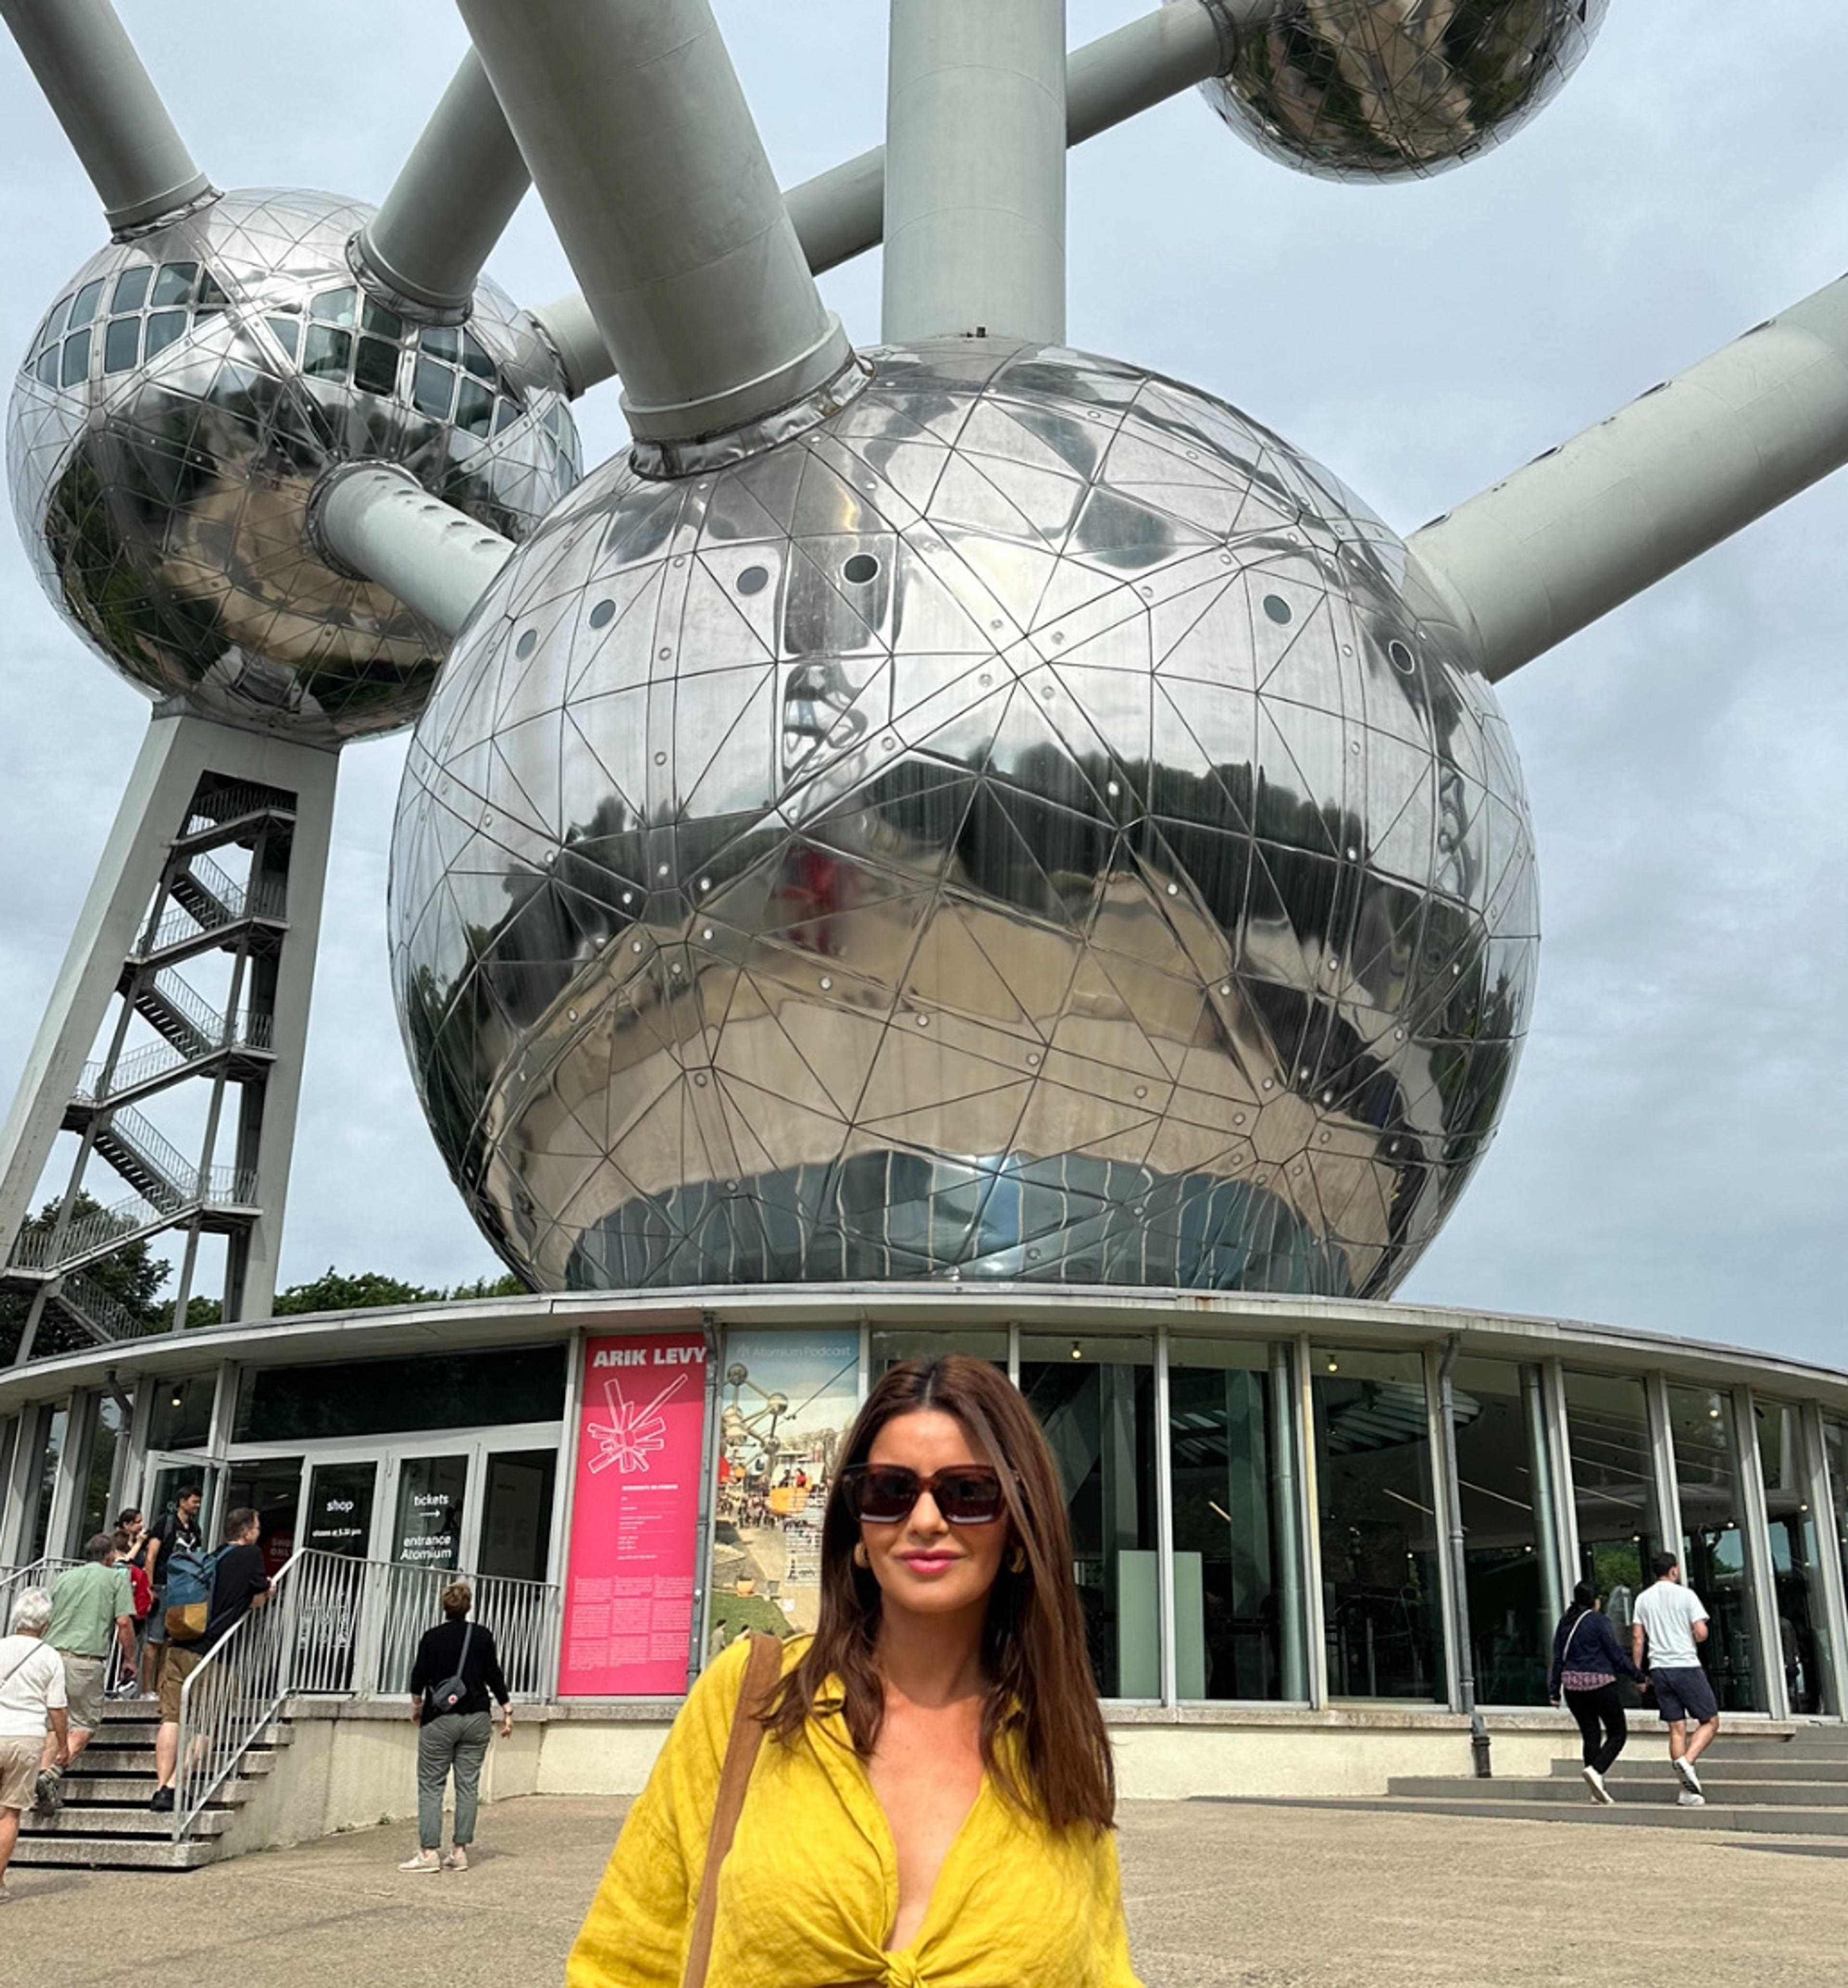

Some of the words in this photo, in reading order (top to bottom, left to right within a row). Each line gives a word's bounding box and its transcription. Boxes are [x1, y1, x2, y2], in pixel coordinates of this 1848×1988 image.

[592, 1349, 647, 1368] ARIK
[654, 1347, 707, 1365] LEVY
[804, 1345, 851, 1358] Podcast
[414, 1493, 449, 1506] tickets
[326, 1500, 354, 1513] shop
[404, 1536, 451, 1547] entrance
[400, 1548, 451, 1560] Atomium
